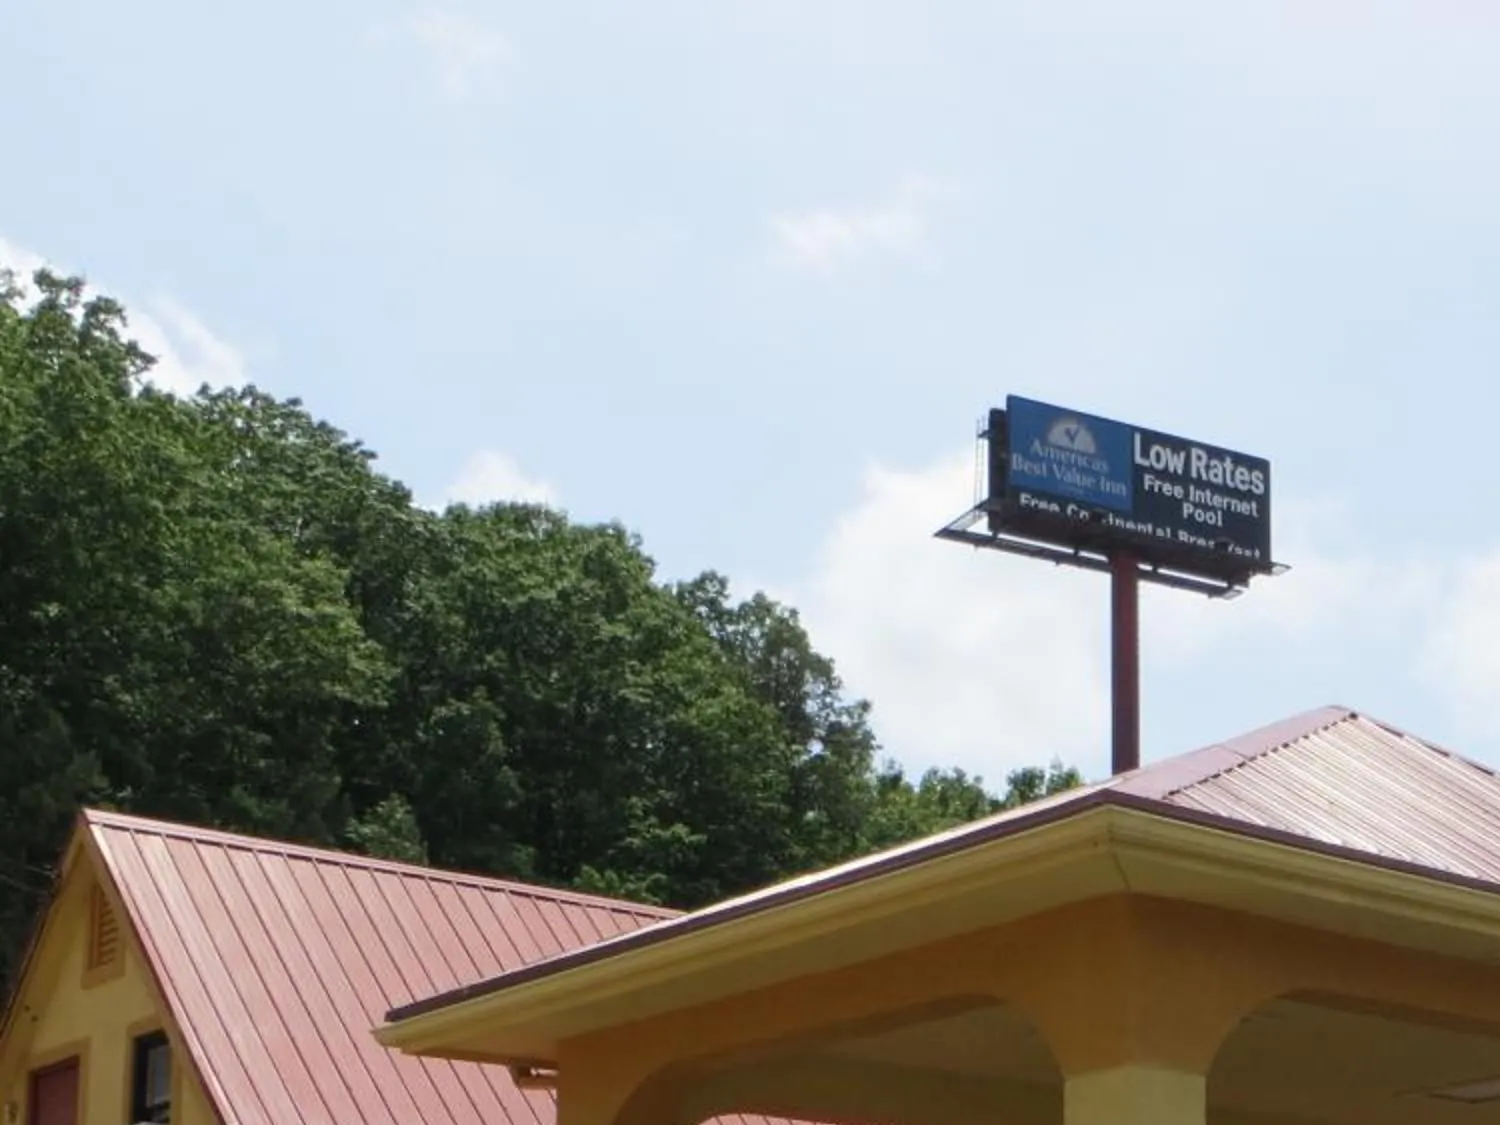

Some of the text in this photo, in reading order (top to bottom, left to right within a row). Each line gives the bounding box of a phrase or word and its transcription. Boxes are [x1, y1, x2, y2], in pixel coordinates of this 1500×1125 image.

[1012, 453, 1047, 479] Best
[1052, 463, 1097, 488] Value
[1100, 476, 1127, 497] Inn
[1133, 432, 1265, 495] Low Rates
[1143, 473, 1259, 518] Free Internet
[1182, 502, 1224, 527] Pool
